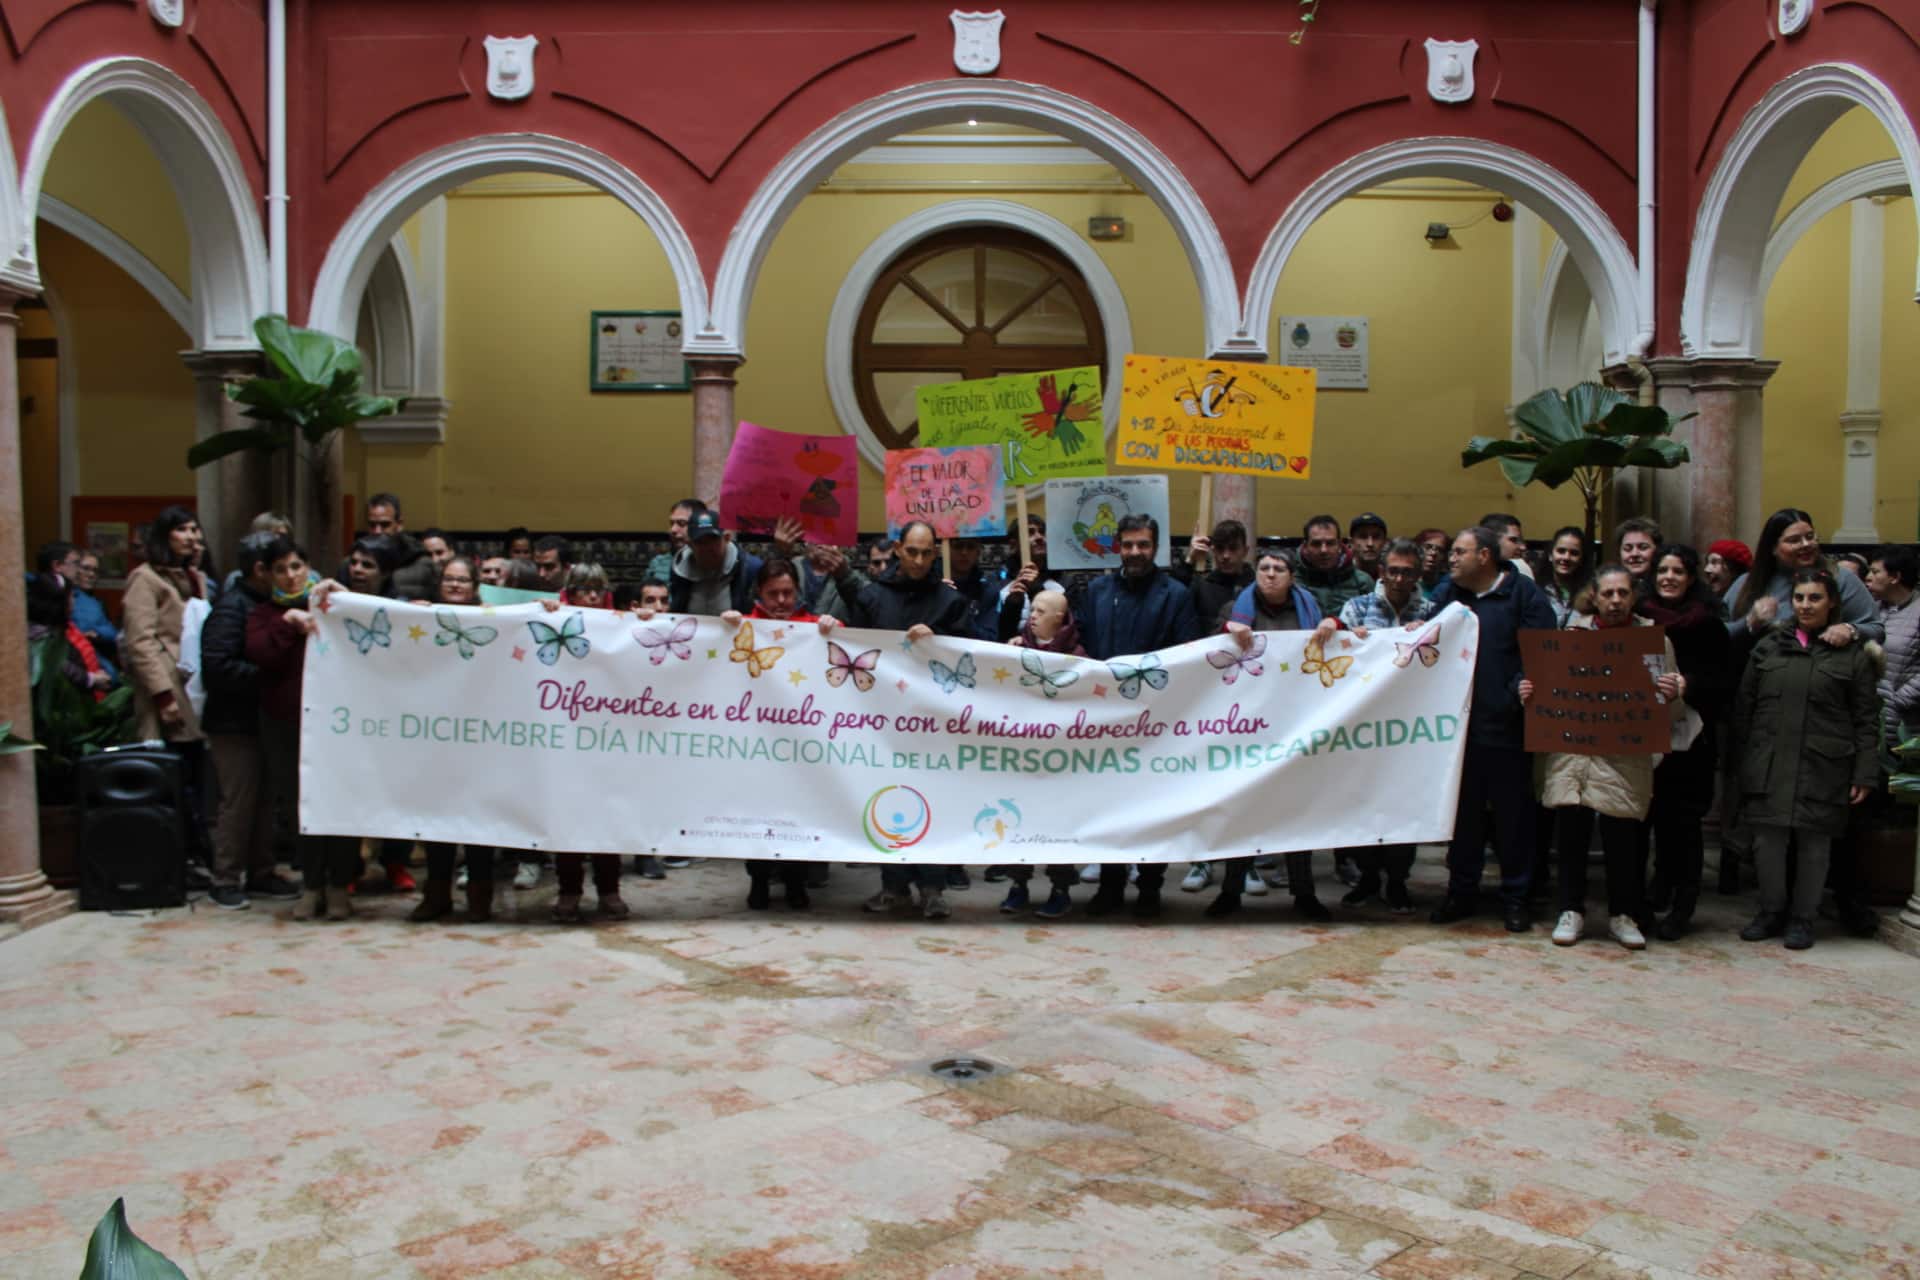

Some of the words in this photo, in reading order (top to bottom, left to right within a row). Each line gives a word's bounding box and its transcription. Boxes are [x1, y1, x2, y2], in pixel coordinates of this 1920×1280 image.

[1248, 369, 1292, 401] CARIDAD
[1123, 440, 1161, 461] CON
[911, 465, 926, 482] EL
[932, 460, 977, 482] VALOR
[905, 495, 982, 518] UNIDAD
[537, 679, 680, 721] Diferentes
[688, 703, 718, 721] en
[725, 690, 753, 722] el
[757, 693, 826, 727] vuelo
[828, 711, 890, 739] pero
[894, 714, 939, 733] con
[946, 704, 974, 735] el
[977, 714, 1061, 739] mismo
[1066, 708, 1169, 740] derecho
[1173, 719, 1192, 736] a
[1198, 703, 1270, 735] volar
[331, 706, 351, 735] 3
[361, 718, 391, 738] DE
[400, 713, 566, 750] DICIEMBRE
[575, 721, 629, 752] DÍA
[637, 729, 885, 768] INTERNACIONAL
[892, 752, 919, 769] DE
[926, 752, 951, 770] LA
[957, 744, 1141, 774] PERSONAS
[1150, 756, 1197, 773] CON
[1207, 714, 1460, 771] DISCAPACIDAD
